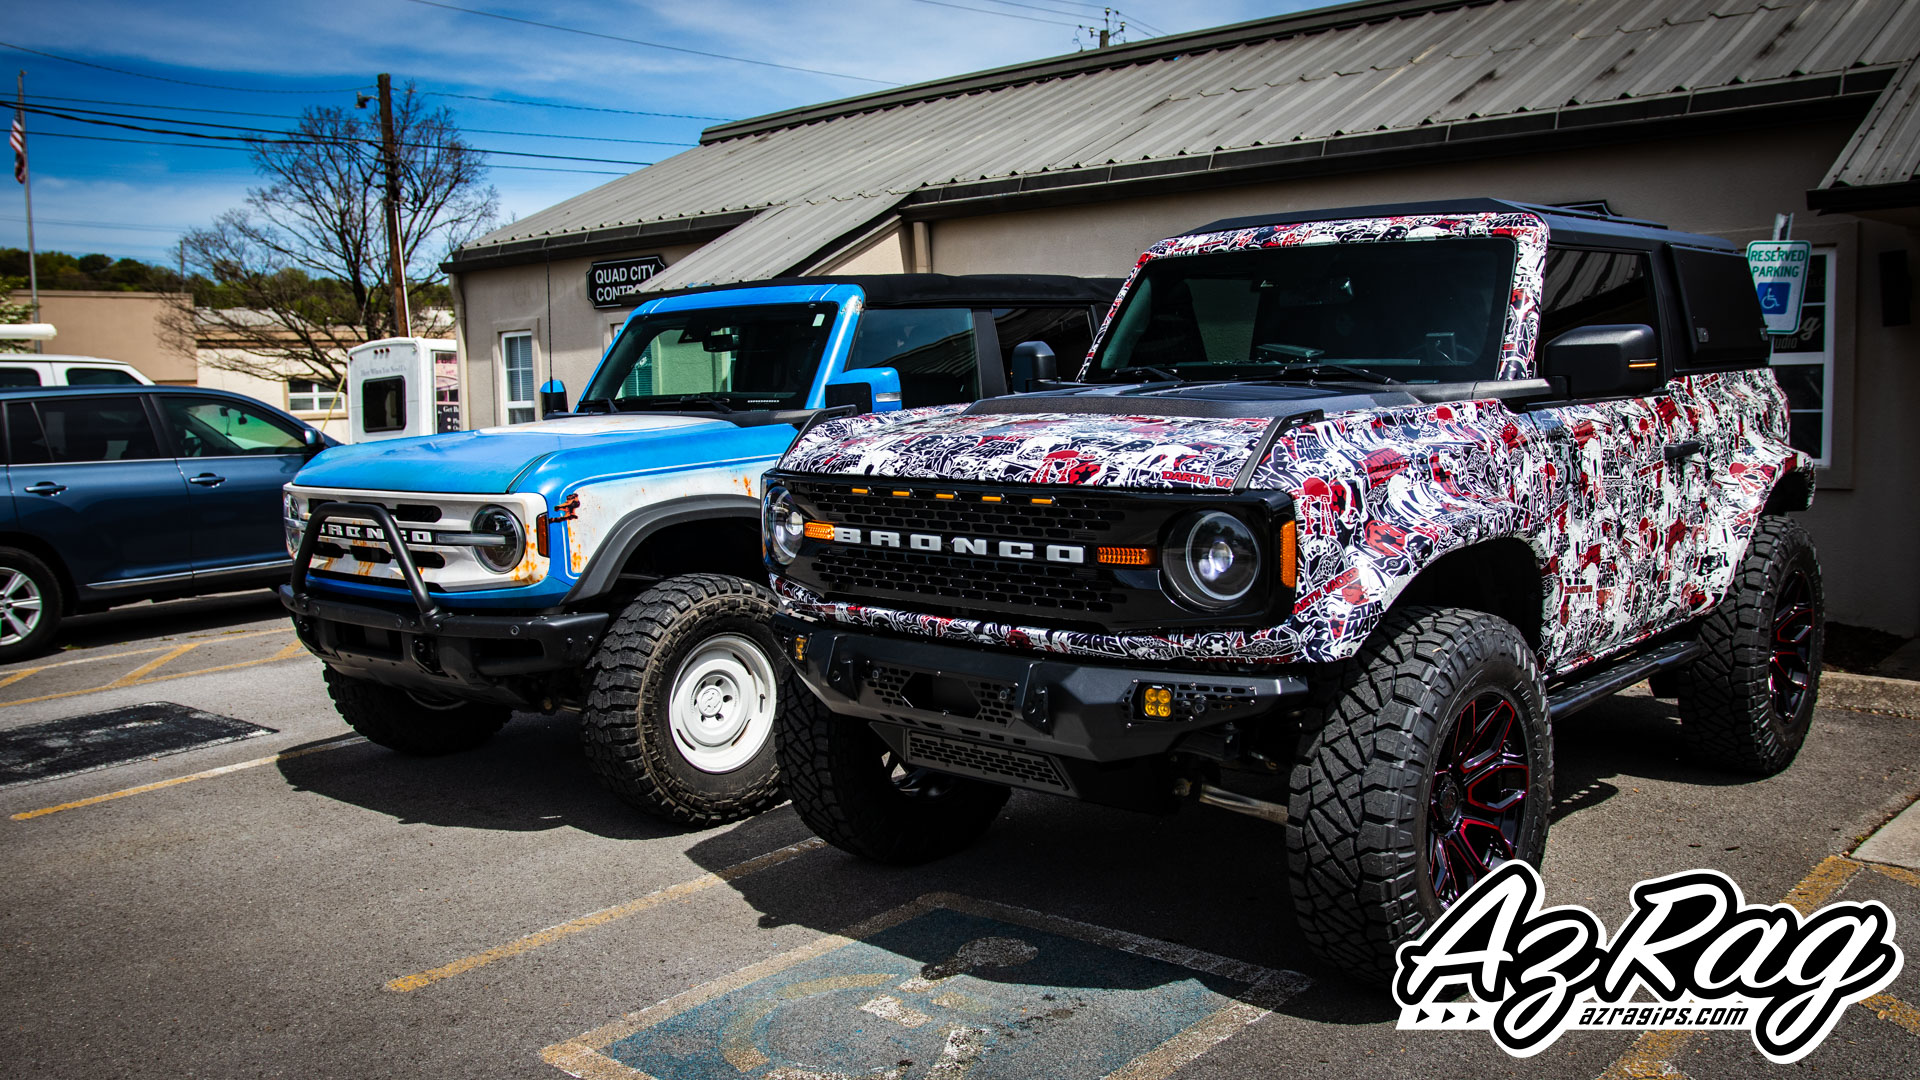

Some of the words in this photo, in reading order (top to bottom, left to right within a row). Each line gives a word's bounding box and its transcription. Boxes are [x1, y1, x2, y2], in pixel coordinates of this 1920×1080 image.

[1750, 250, 1805, 262] RESERVED
[595, 267, 627, 284] QUAD
[630, 264, 655, 280] CITY
[1752, 265, 1800, 277] PARKING
[1162, 471, 1210, 485] DARTH
[834, 527, 1084, 563] BRONCO
[1323, 567, 1359, 594] VADER
[1348, 600, 1384, 621] STAR
[1344, 614, 1384, 637] WAR
